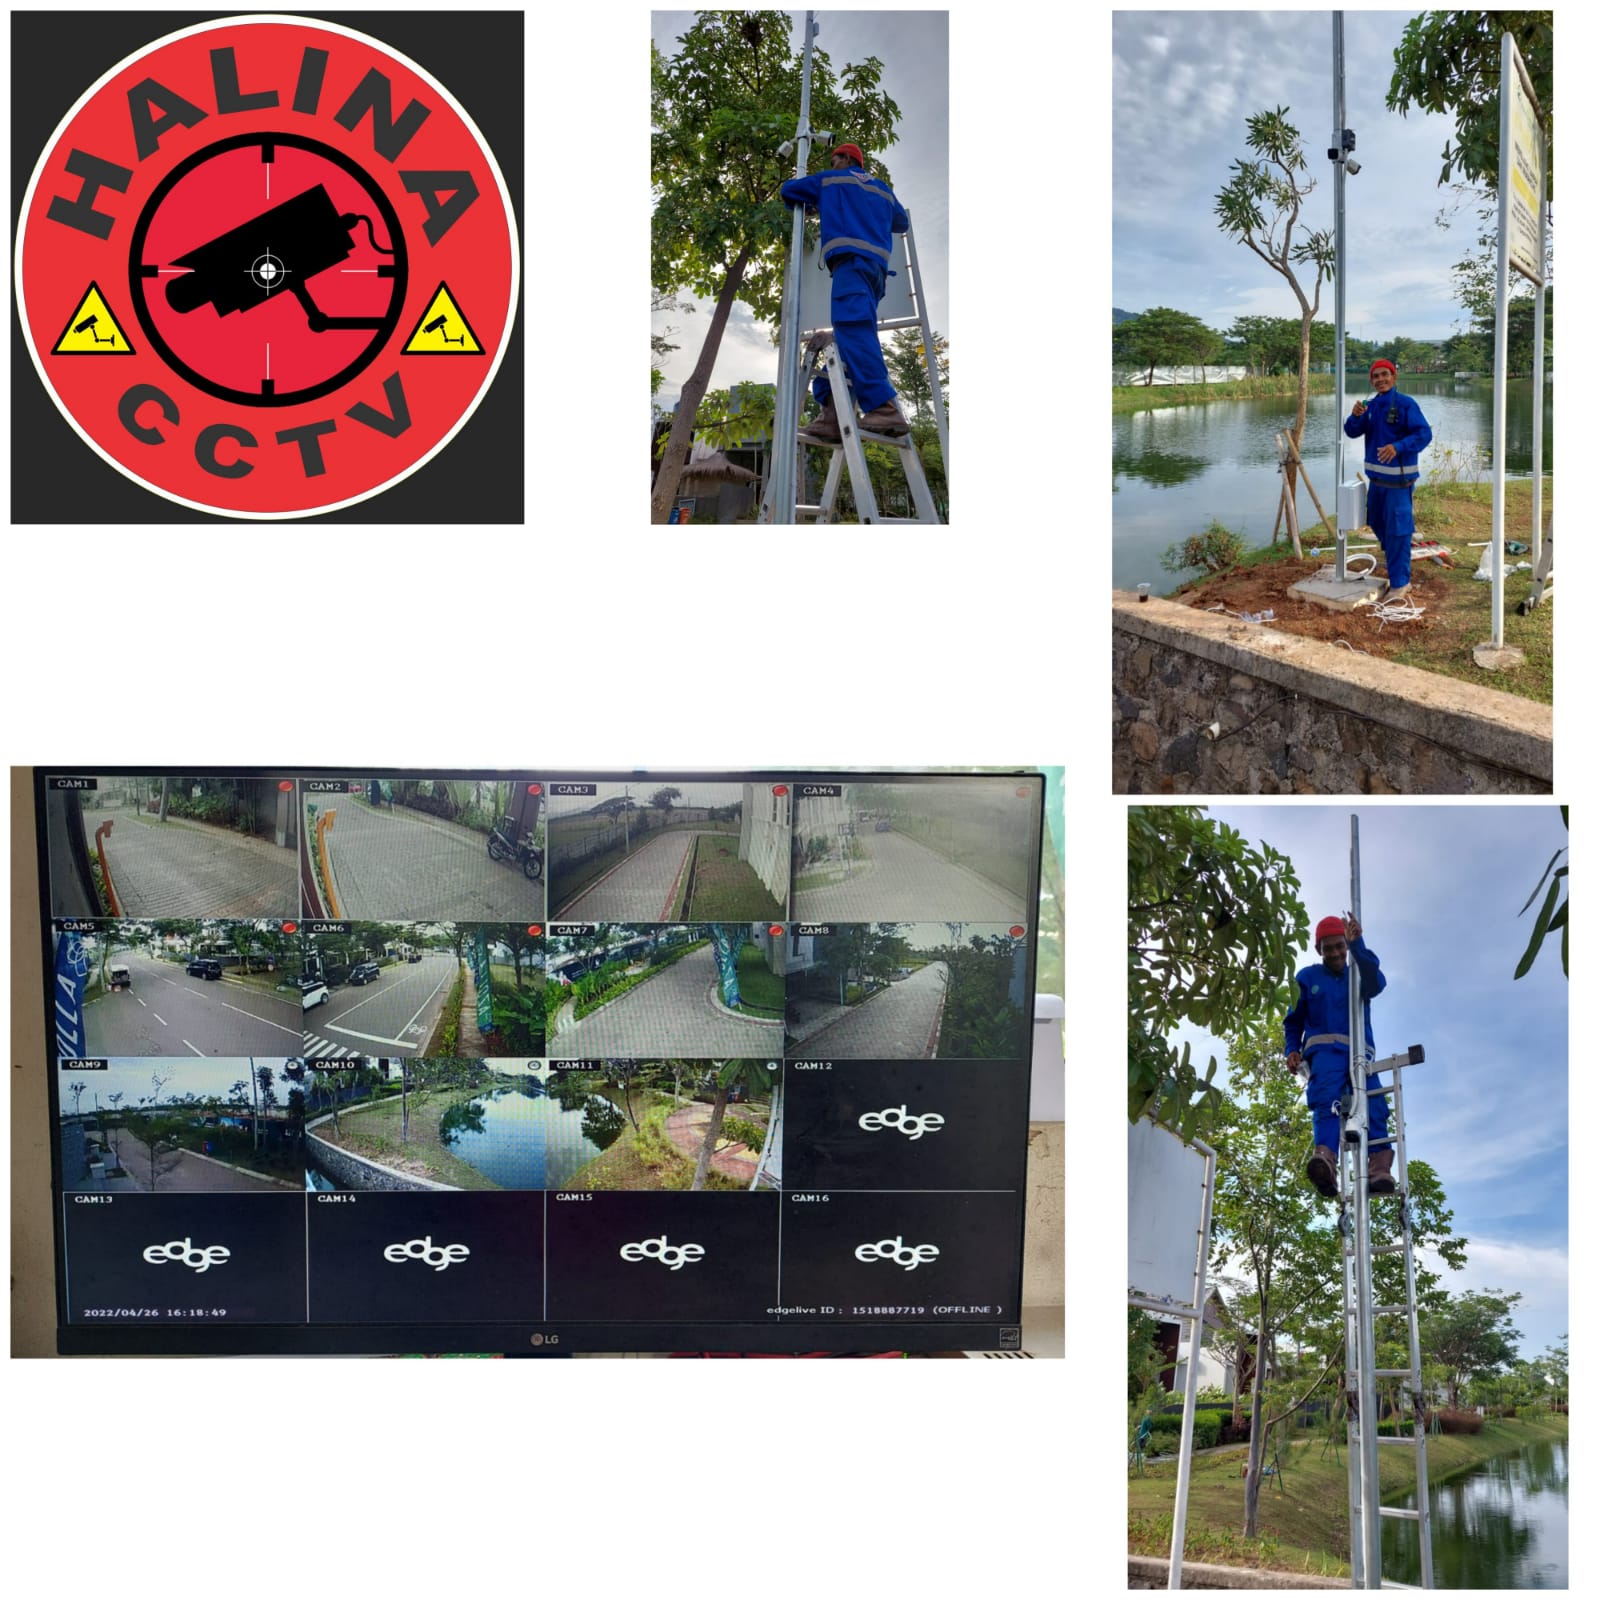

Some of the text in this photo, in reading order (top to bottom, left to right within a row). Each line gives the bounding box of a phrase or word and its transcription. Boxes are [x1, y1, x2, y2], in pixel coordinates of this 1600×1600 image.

[46, 46, 480, 248] HALINA
[117, 371, 412, 480] CCTV
[57, 779, 89, 788] CAM1
[309, 781, 341, 791] CAM2
[557, 784, 589, 794] CAM3
[802, 785, 834, 795] CAM4
[63, 921, 95, 931] CAM5
[312, 923, 345, 932] CAM6
[556, 925, 588, 935] CAM7
[798, 925, 830, 935] CAM8
[68, 1060, 101, 1069] CAM9
[316, 1060, 355, 1070] CAM10
[556, 1060, 593, 1070] CAM11
[794, 1061, 833, 1071] CAM12
[858, 1105, 945, 1140] edge
[74, 1194, 113, 1204] CAM13
[317, 1194, 356, 1203] CAM14
[556, 1192, 593, 1202] CAM15
[791, 1193, 830, 1203] CAM16
[143, 1237, 231, 1272] edge
[383, 1236, 470, 1271] edge
[620, 1235, 705, 1270] edge
[855, 1236, 940, 1271] edge
[83, 1308, 227, 1317] 2022/04/26 16:18:49
[766, 1305, 817, 1316] edgelive
[820, 1306, 835, 1315] ID
[852, 1306, 925, 1315] 1518887719
[545, 1335, 559, 1344] LG
